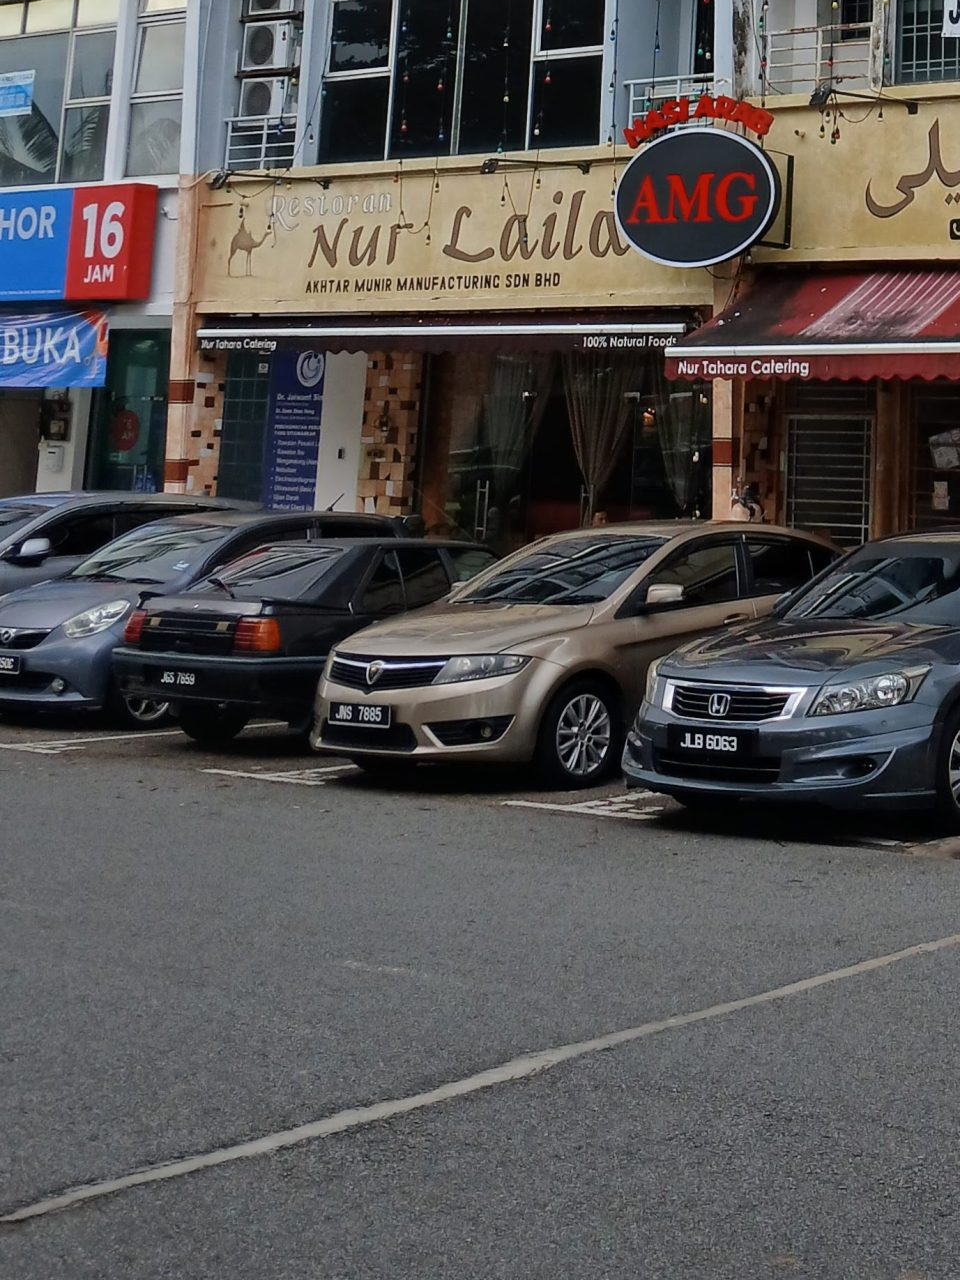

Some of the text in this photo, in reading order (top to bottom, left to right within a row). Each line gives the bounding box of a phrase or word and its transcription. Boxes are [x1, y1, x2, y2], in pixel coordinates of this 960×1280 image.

[623, 95, 774, 149] NASI ARAB
[625, 172, 759, 224] AMG
[268, 193, 392, 231] Restoran
[83, 201, 126, 259] 16
[307, 190, 631, 268] Nur Laila
[84, 264, 115, 283] JAM
[305, 272, 561, 294] AKHTAR MUNIR MANUFACTURING SDN BHD
[3, 326, 81, 364] BUKA
[215, 339, 242, 349] Tahara
[243, 338, 277, 351] Catering
[583, 336, 607, 348] 100%
[609, 335, 646, 348] Natural
[678, 358, 809, 376] Nur Tahara Catering
[335, 705, 382, 722] JNS 7885
[680, 732, 738, 752] JLB 6063
